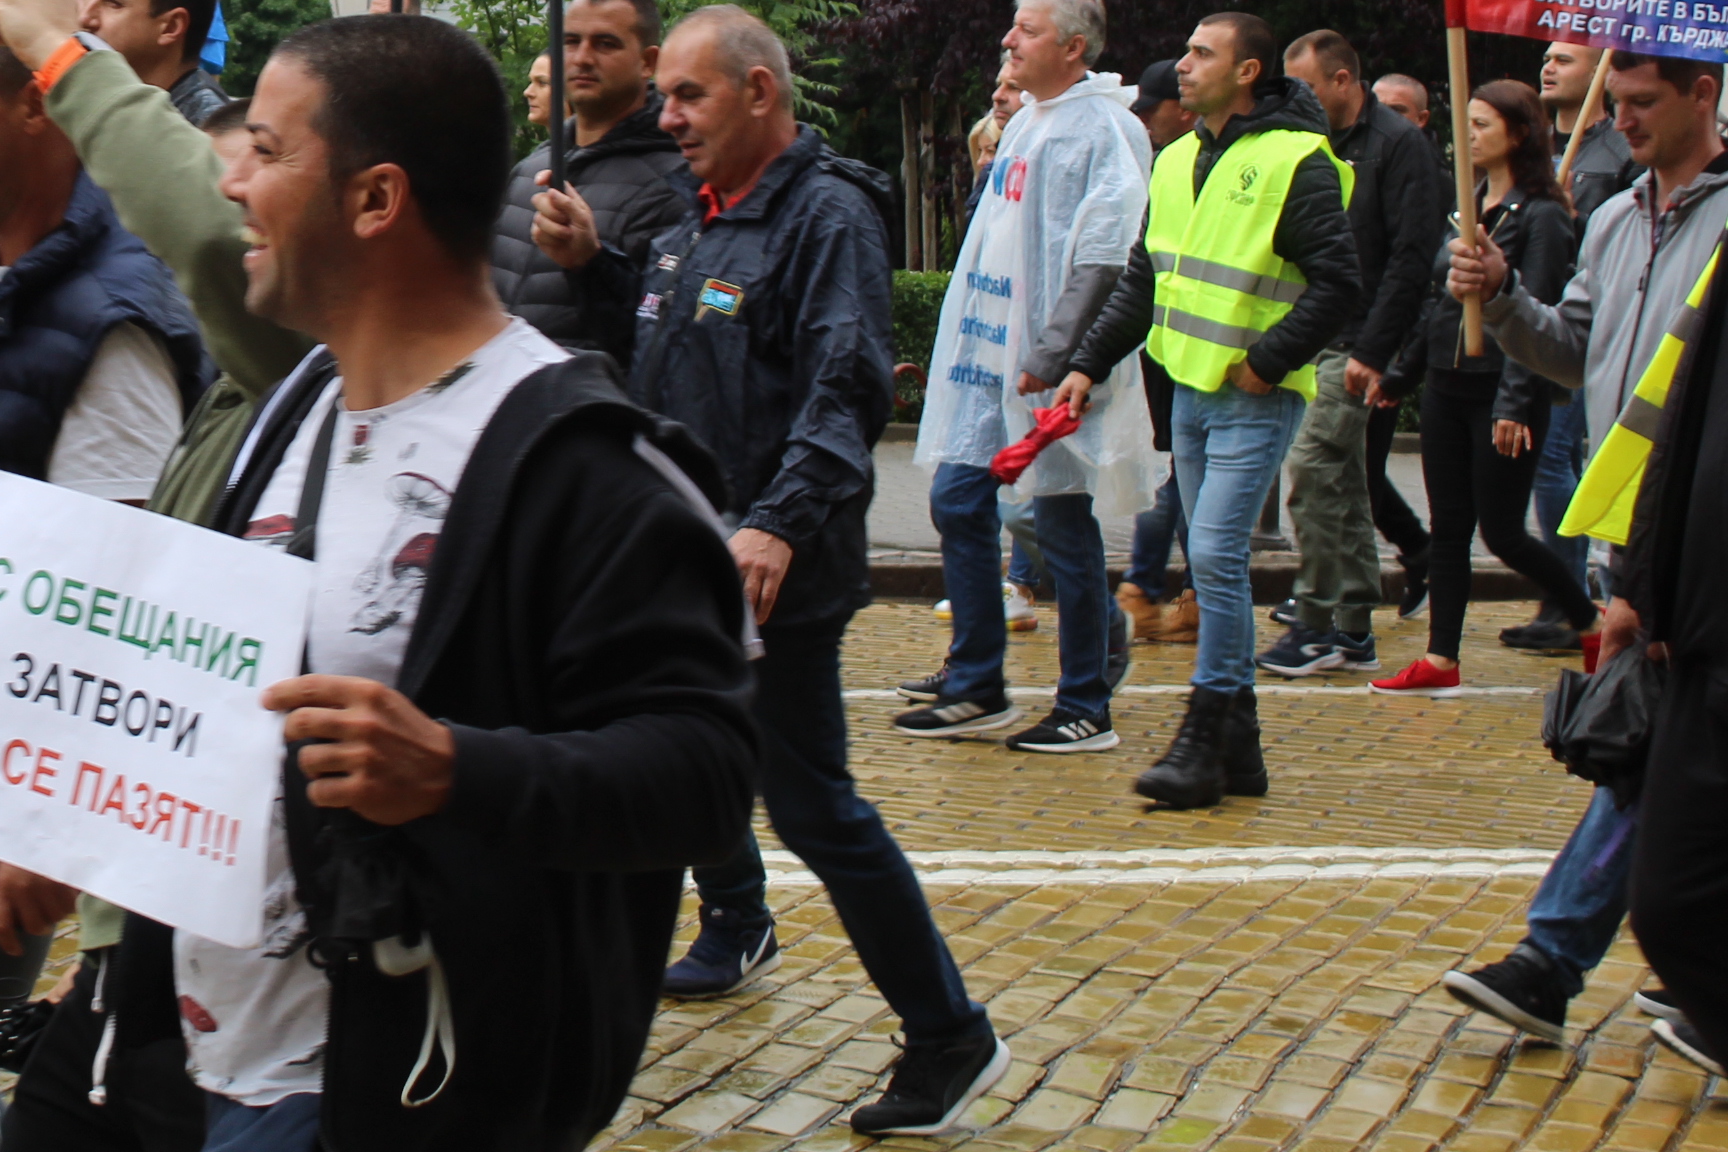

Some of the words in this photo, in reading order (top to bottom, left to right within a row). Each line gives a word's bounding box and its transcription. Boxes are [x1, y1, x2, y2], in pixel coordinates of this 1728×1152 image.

[1537, 10, 1617, 35] АРЕСТ
[1621, 24, 1651, 43] гр.
[1673, 1, 1687, 19] В
[23, 569, 265, 688] ОБЕЩАНИЯ
[5, 652, 204, 759] ЗАТВОРИ
[0, 739, 63, 798] СЕ
[69, 761, 241, 867] ПАЗЯТ!!!
